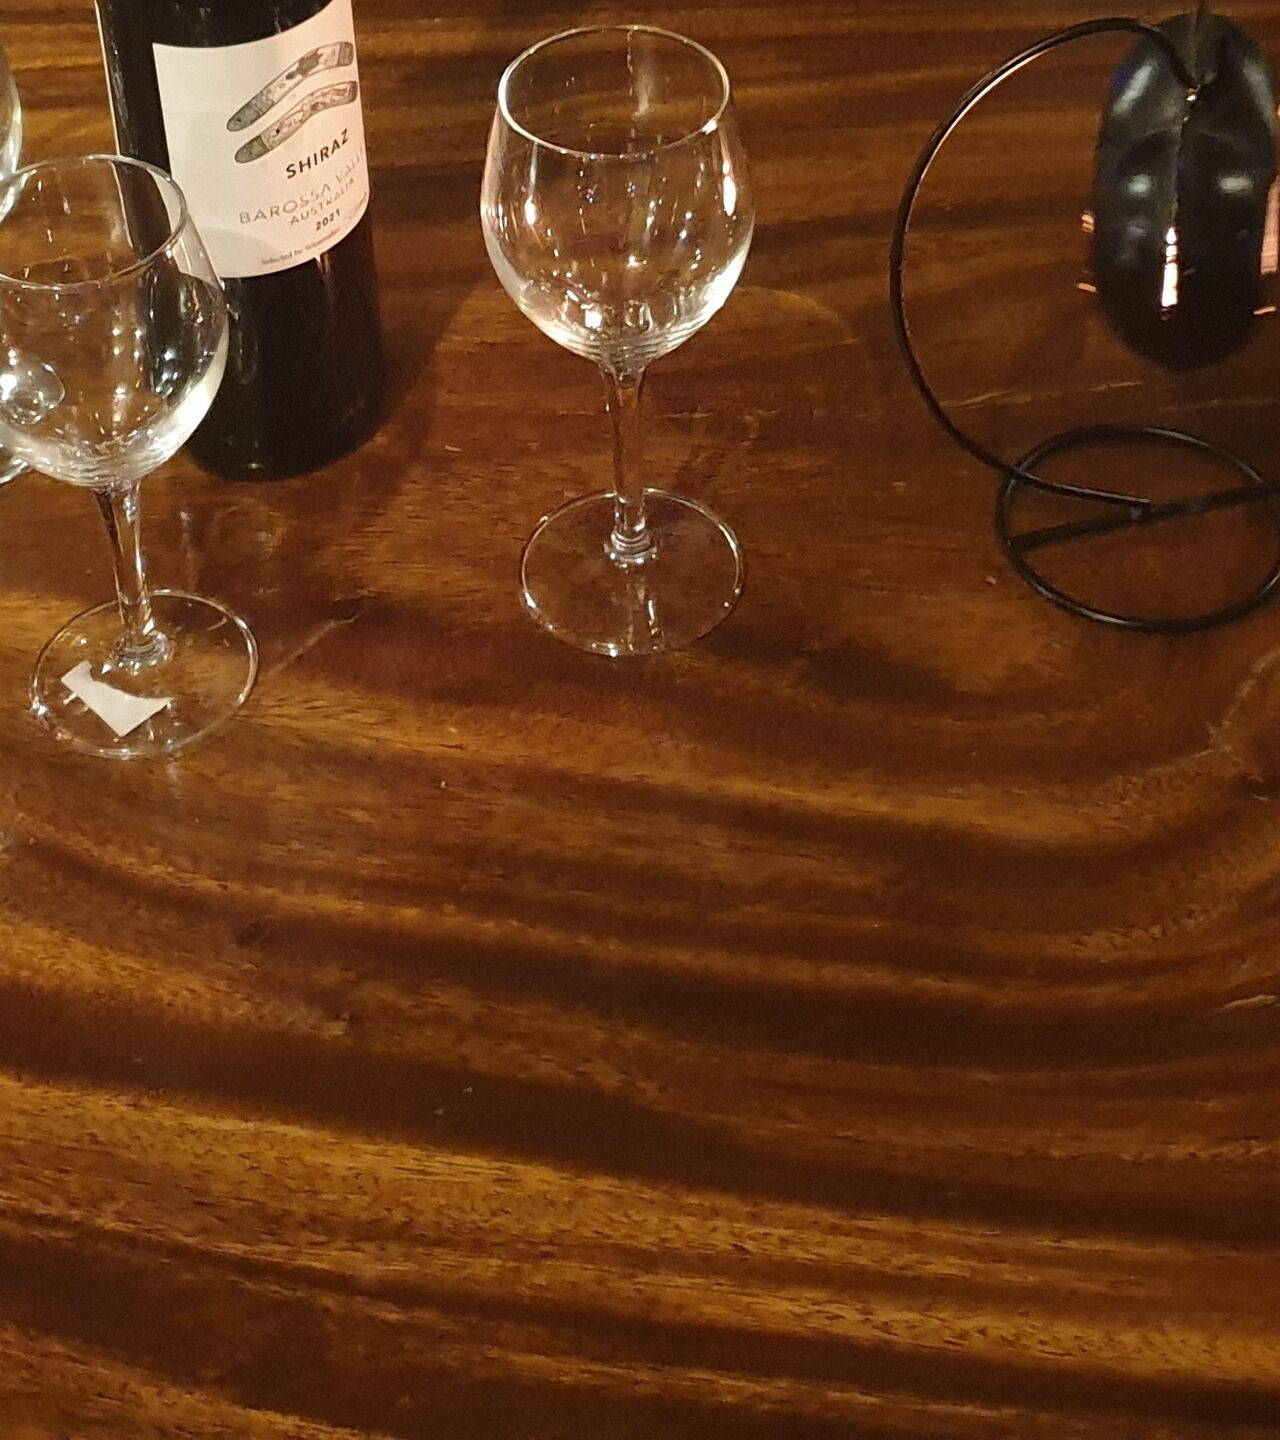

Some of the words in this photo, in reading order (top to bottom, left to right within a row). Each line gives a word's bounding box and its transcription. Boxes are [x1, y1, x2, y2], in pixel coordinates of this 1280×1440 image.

[285, 127, 350, 180] SHIRAZ
[239, 182, 332, 225] BAROSSA
[290, 177, 355, 226] AUSTRALIA
[315, 207, 341, 232] 2021
